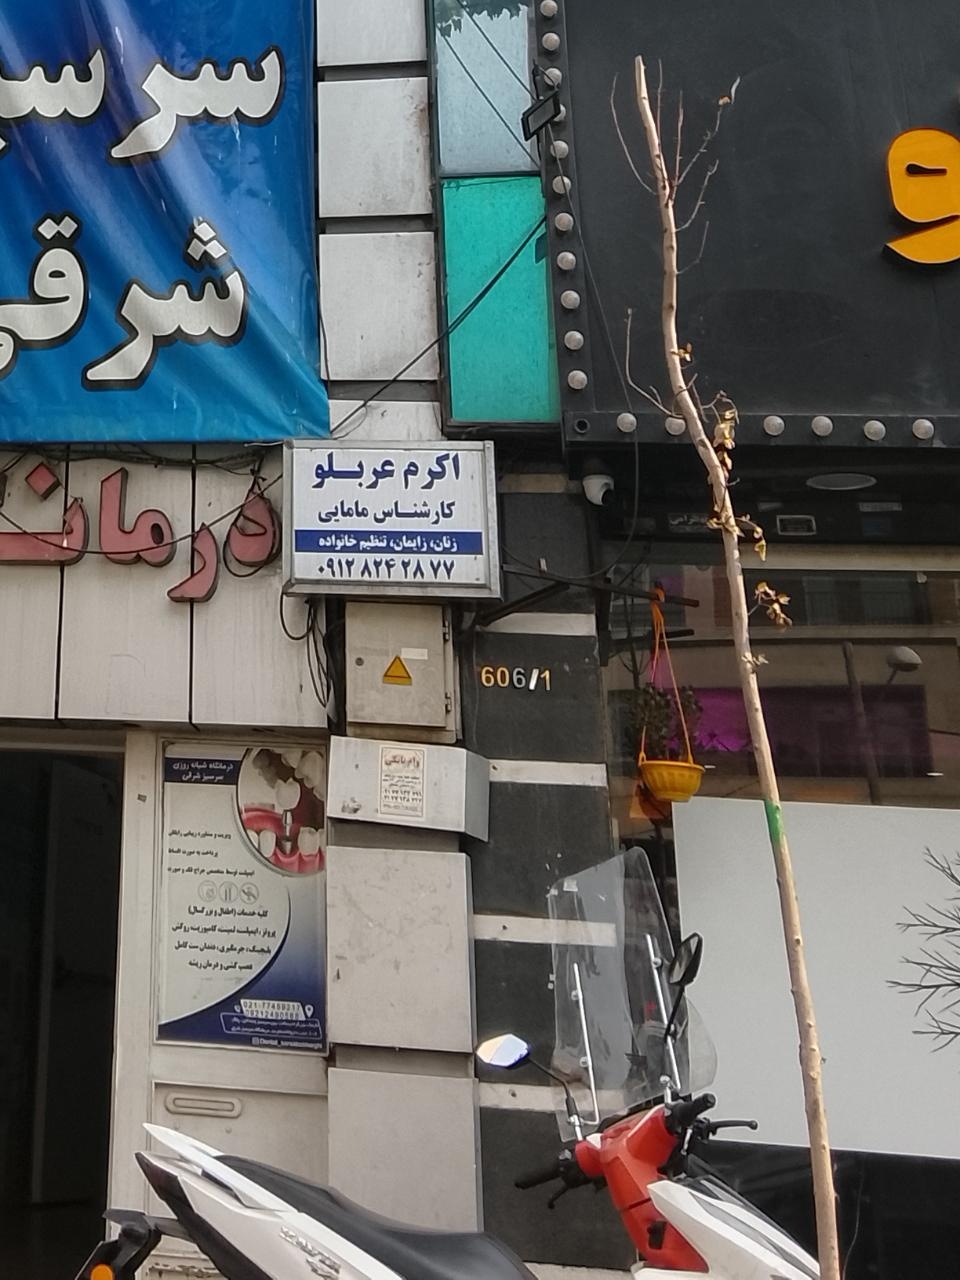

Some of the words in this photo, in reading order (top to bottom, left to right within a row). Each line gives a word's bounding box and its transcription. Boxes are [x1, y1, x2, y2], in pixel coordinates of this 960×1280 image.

[312, 451, 395, 489] عربلو
[403, 452, 460, 490] اکرم
[317, 499, 369, 523] مامایی
[373, 500, 455, 525] کارشناس
[318, 534, 357, 551] خانواده
[359, 534, 387, 551] تنظیم
[480, 666, 551, 691] 606/1
